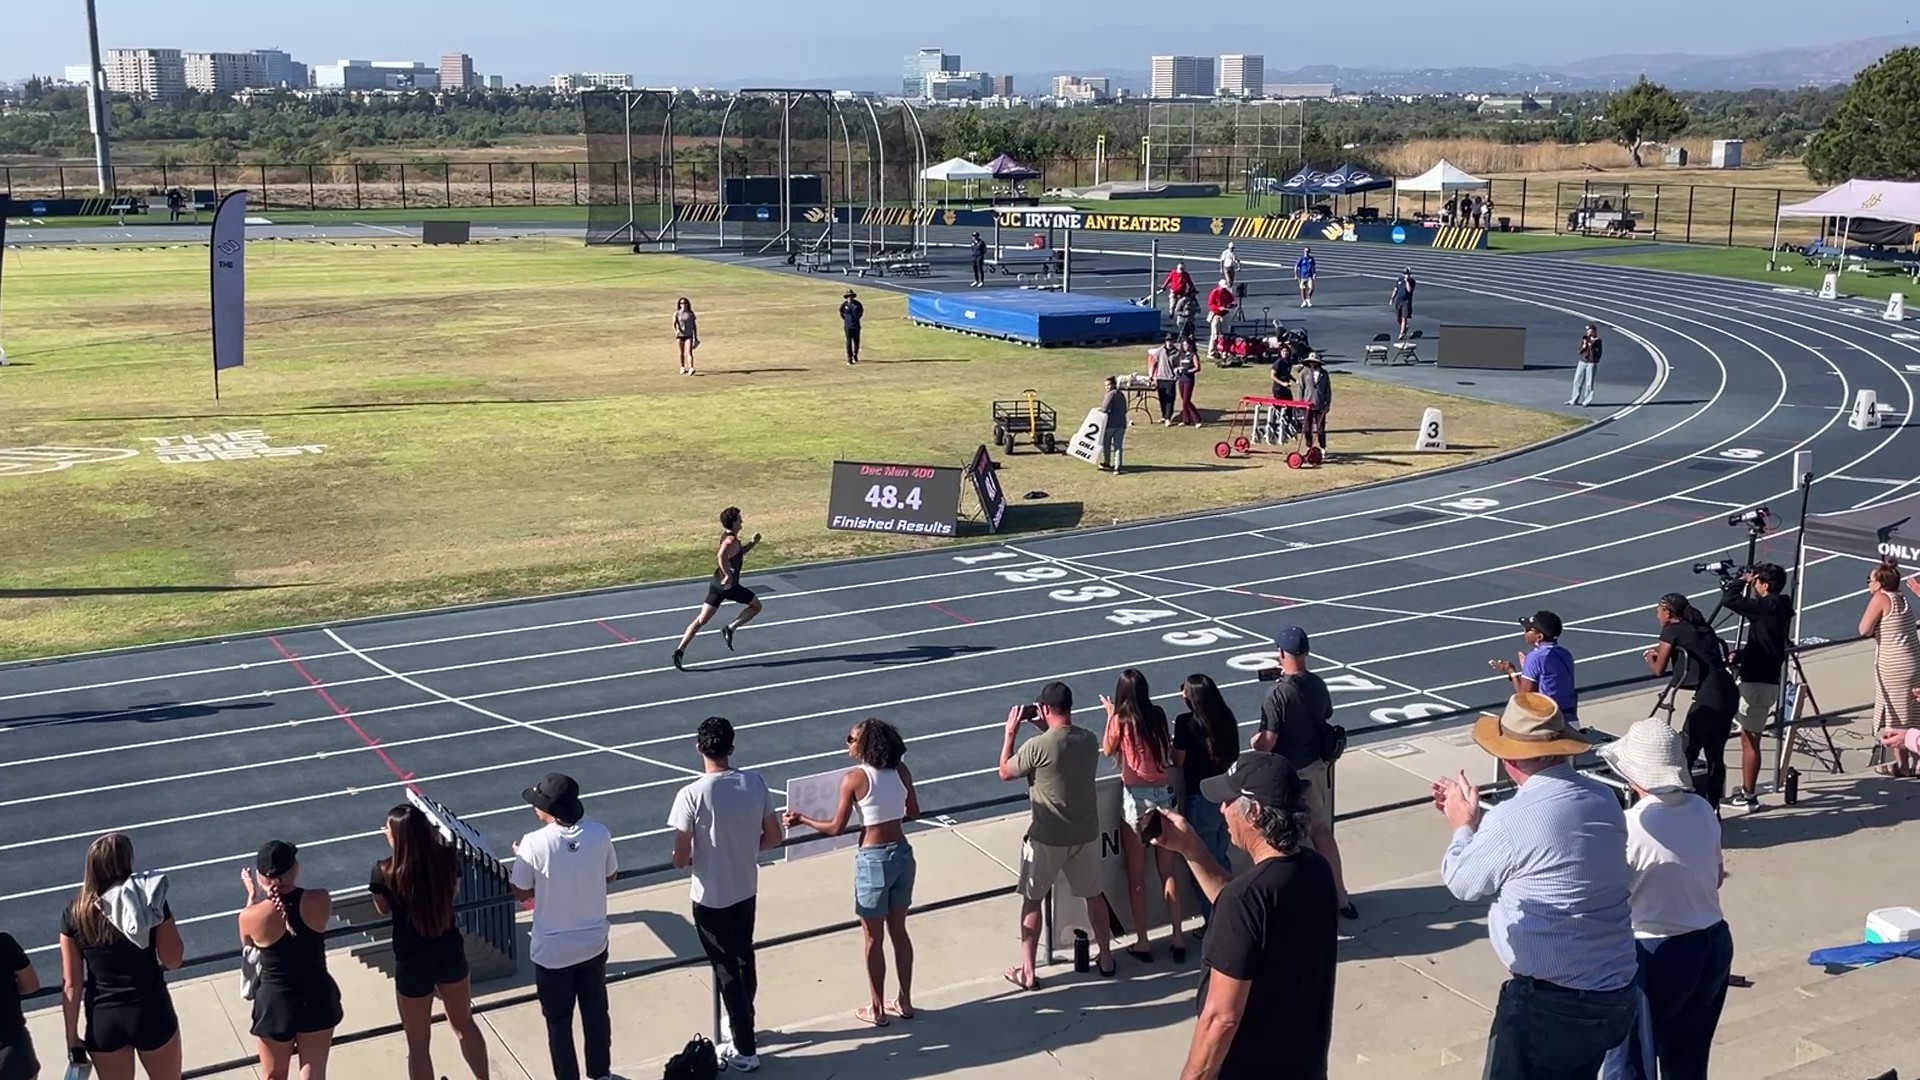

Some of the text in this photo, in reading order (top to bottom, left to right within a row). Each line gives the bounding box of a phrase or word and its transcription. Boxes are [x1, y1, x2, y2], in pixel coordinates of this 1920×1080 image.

[1000, 213, 1181, 232] UC IRVINE ANTEATERS
[1825, 281, 1831, 292] 8
[1891, 301, 1898, 312] 7
[1868, 402, 1875, 418] 4
[139, 430, 270, 446] THE
[1084, 423, 1099, 441] 2
[1427, 421, 1439, 439] 3
[911, 468, 935, 479] 400
[865, 484, 922, 510] 48.4
[832, 516, 951, 533] Finished Results
[952, 551, 1018, 564] 1
[1878, 542, 1920, 561] ONLY
[994, 567, 1069, 583] 2
[1048, 586, 1121, 602] 3
[1105, 608, 1178, 625] 4
[1161, 627, 1244, 647] 5
[1225, 651, 1284, 672] 6
[1324, 674, 1387, 693] 7
